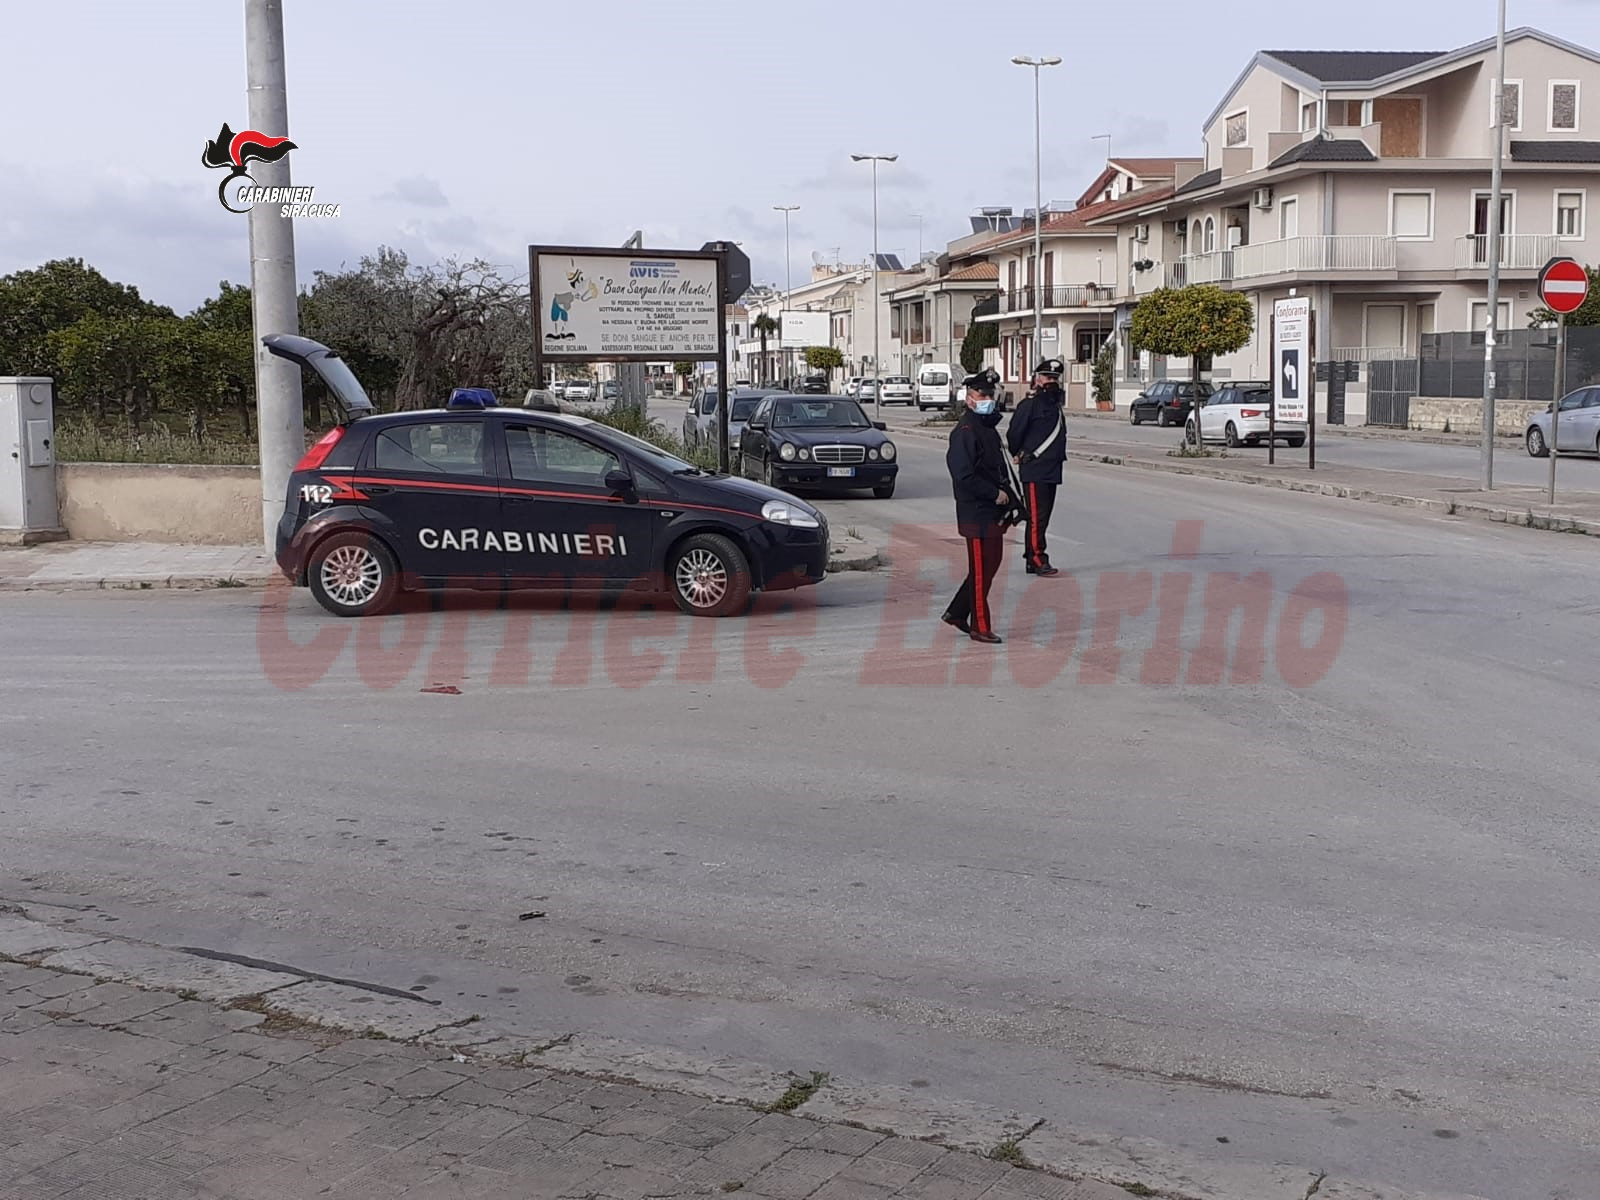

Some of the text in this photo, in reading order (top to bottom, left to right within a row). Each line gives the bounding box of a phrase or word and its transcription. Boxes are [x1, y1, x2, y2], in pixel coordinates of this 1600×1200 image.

[630, 267, 659, 278] AVIS
[627, 280, 657, 299] Sangue
[658, 280, 676, 295] Non
[1276, 304, 1307, 318] Conforama
[601, 333, 610, 342] SE
[613, 333, 629, 342] DONI
[632, 333, 657, 342] SANGUE
[669, 333, 690, 342] ANCHE
[693, 333, 704, 342] PER
[707, 333, 716, 342] TE
[301, 484, 334, 503] 112
[418, 527, 627, 556] CARABINIERI
